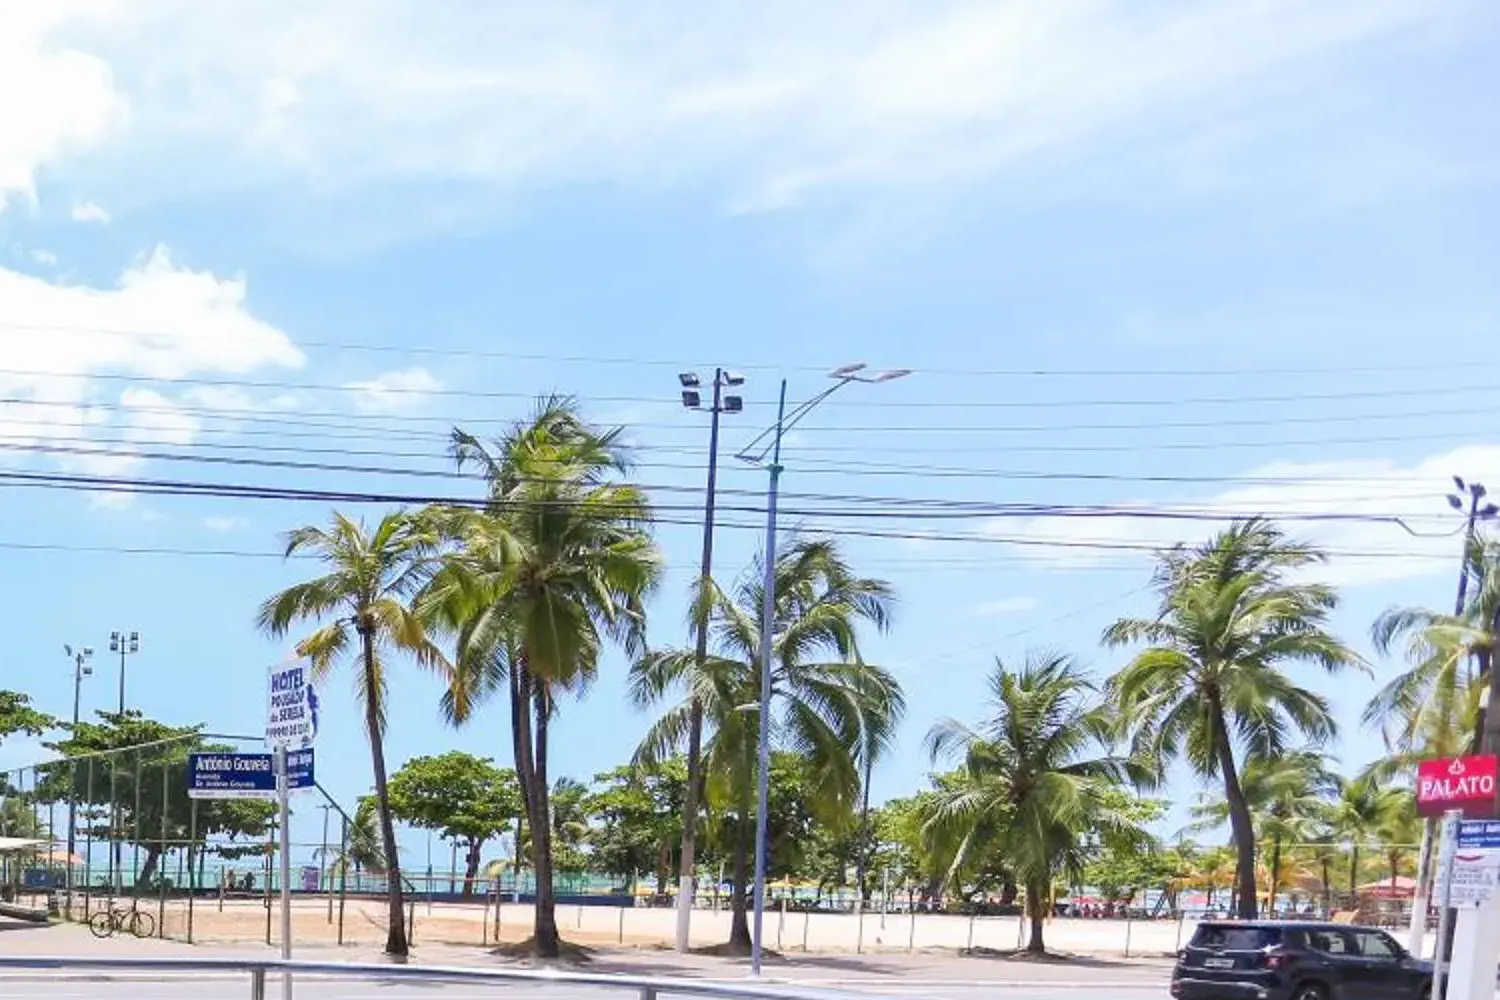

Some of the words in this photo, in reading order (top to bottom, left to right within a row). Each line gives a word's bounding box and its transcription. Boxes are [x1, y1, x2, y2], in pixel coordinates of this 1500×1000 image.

[271, 668, 304, 693] HOTEL
[233, 755, 271, 771] Gouveia
[1420, 775, 1494, 800] PALATO
